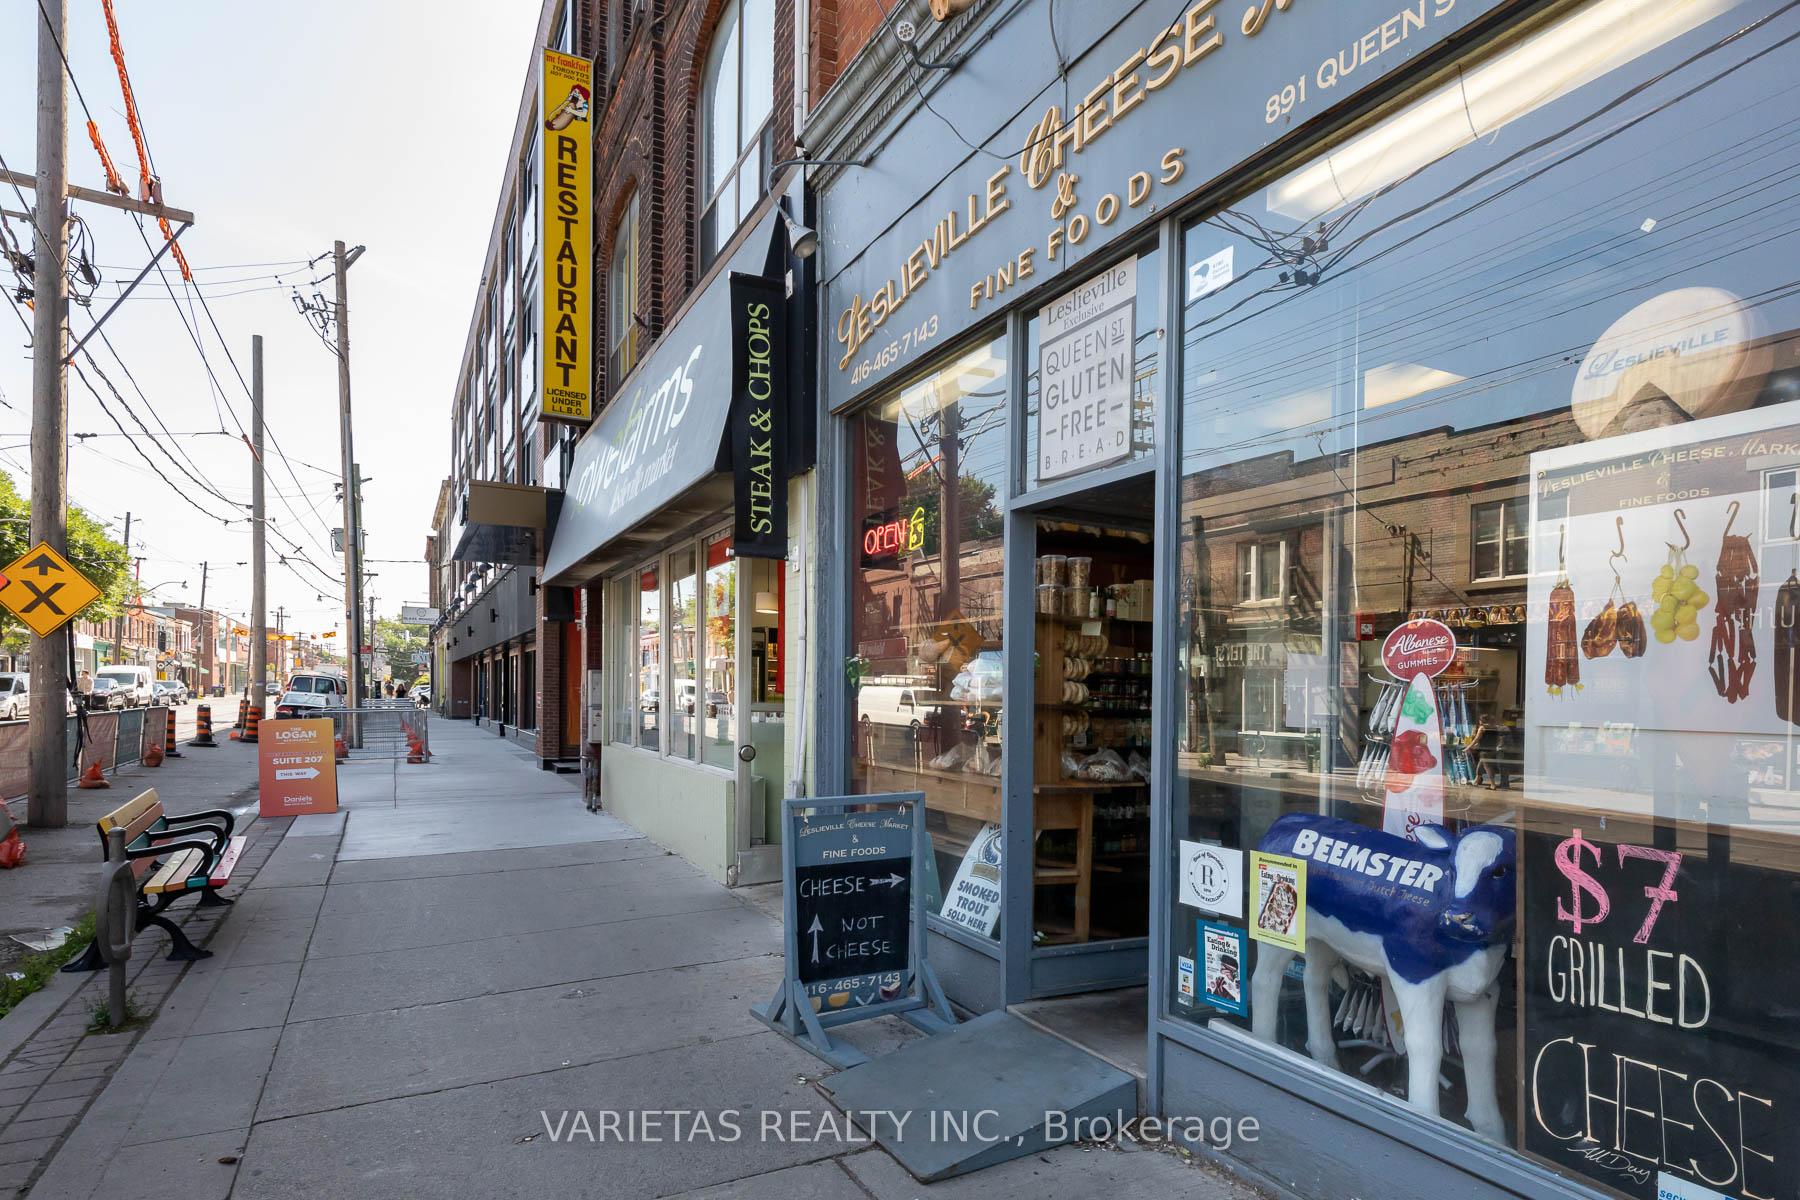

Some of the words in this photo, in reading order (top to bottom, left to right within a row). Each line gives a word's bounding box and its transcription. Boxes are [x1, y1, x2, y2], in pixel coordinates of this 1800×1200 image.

[1265, 74, 1306, 125] 891
[1316, 0, 1426, 88] QUEEN
[837, 164, 1011, 370] LESLIEVILLE
[1020, 0, 1224, 190] CHEESE
[1051, 172, 1079, 220] &
[970, 247, 1036, 310] FINE
[1047, 148, 1185, 261] FOODS
[555, 135, 579, 387] RESTAURANT
[1047, 269, 1127, 326] Leslieville
[1063, 301, 1104, 331] Exclusive
[748, 303, 771, 400] CHOPS
[1046, 325, 1107, 376] QUEEN
[1045, 353, 1124, 411] GLUTEN
[547, 388, 587, 401] LICENSED
[552, 397, 582, 408] UNDER
[552, 405, 584, 416] L.L.B.O.
[749, 407, 772, 432] &
[750, 438, 772, 534] STEAK
[1617, 495, 1653, 508] FINE
[1656, 487, 1710, 504] FOODS
[864, 518, 907, 554] OPEN
[1388, 633, 1449, 657] Albanese
[1397, 657, 1438, 670] GUMMIES
[275, 730, 318, 740] LOGAN
[272, 757, 302, 765] SUITE
[304, 755, 323, 763] 207
[283, 796, 313, 804] Daniels
[846, 818, 877, 830] CHEESE
[880, 817, 910, 831] MARKET
[851, 834, 859, 844] &
[822, 850, 847, 859] FINE
[850, 846, 887, 857] FOODS
[1292, 828, 1444, 893] BEEMSTER
[799, 875, 866, 898] CHEESE
[1200, 863, 1215, 888] R
[1261, 870, 1274, 881] Eating
[1277, 873, 1296, 885] Drinking
[1554, 828, 1682, 945] $7
[957, 880, 1000, 904] SMOKED
[956, 895, 990, 917] TROUT
[841, 915, 885, 932] NOT
[946, 908, 966, 924] SOLD
[966, 915, 988, 932] HERE
[826, 939, 891, 960] CHEESE
[1207, 935, 1226, 949] Eating
[1211, 943, 1238, 957] Drinking
[1549, 935, 1711, 1028] GRILLED
[1532, 1036, 1776, 1200] CHEESE
